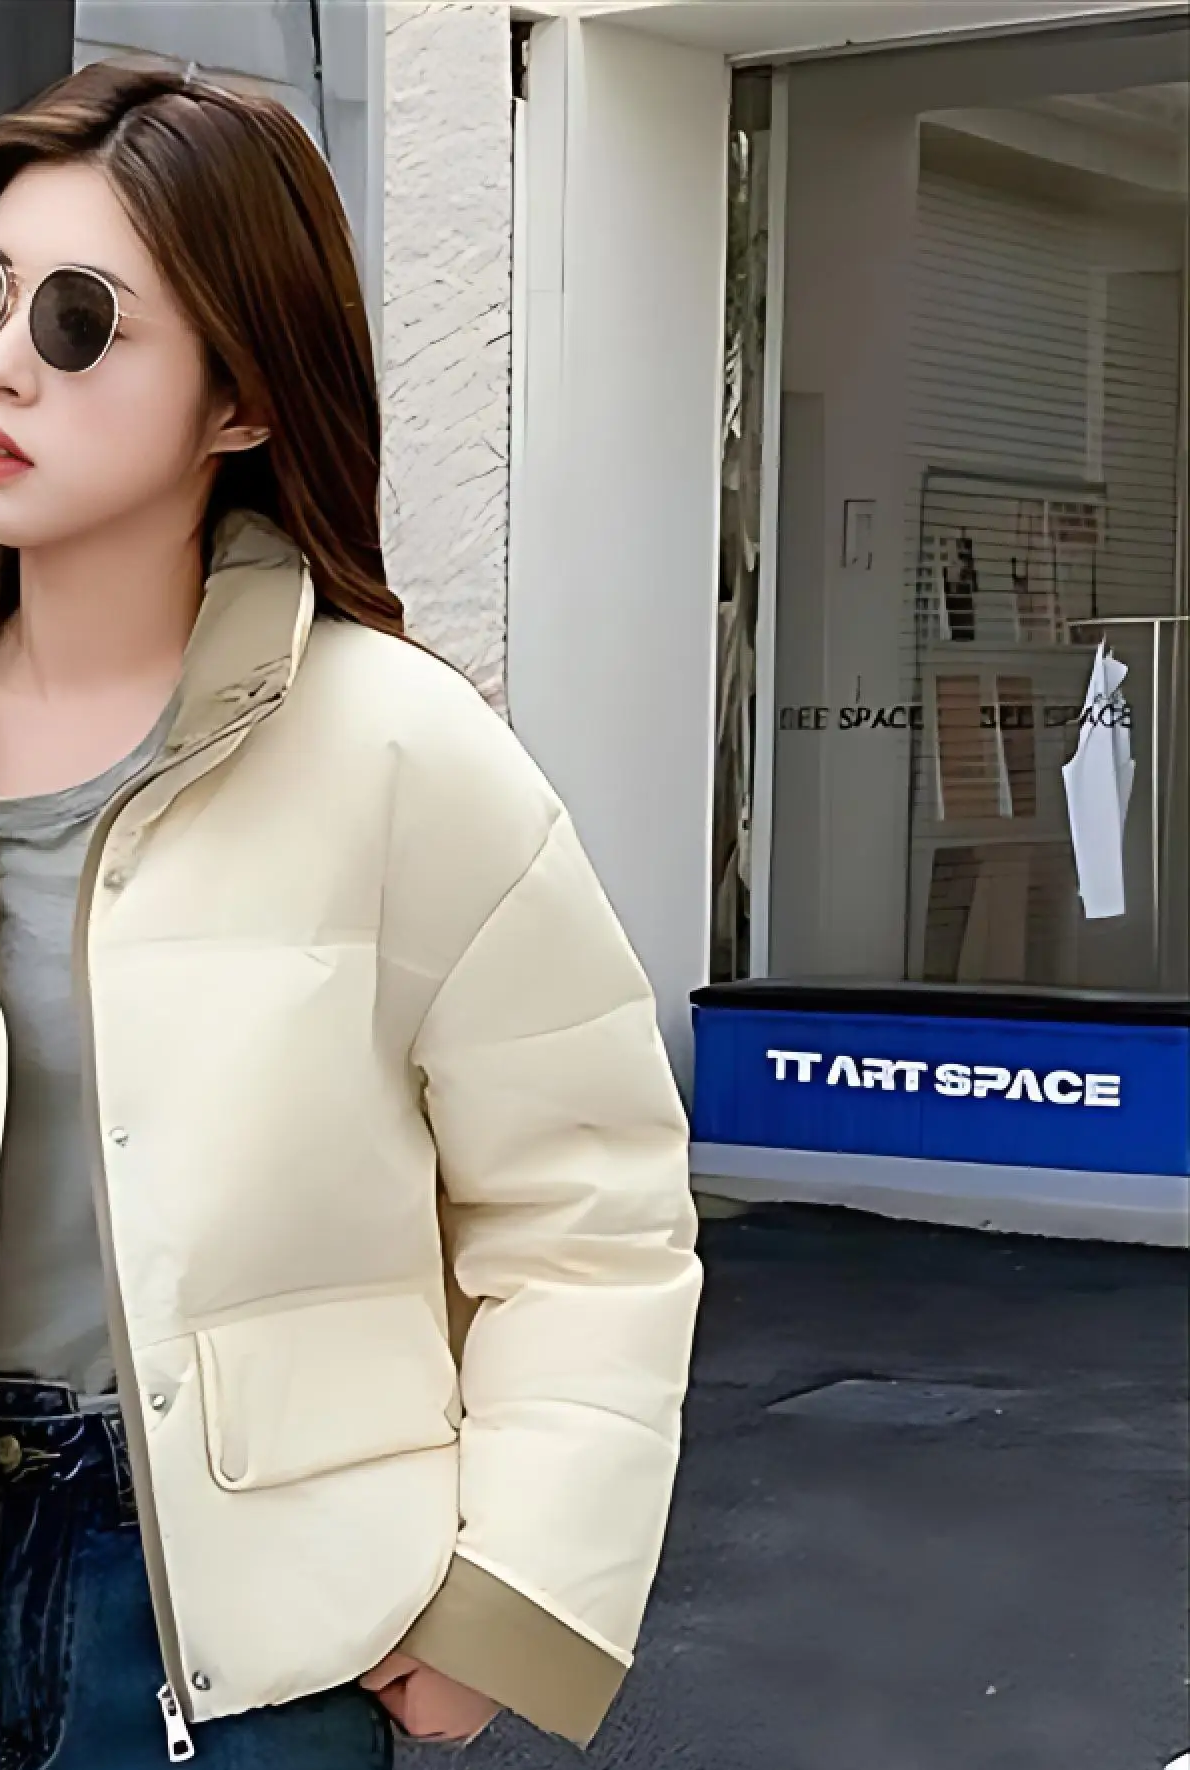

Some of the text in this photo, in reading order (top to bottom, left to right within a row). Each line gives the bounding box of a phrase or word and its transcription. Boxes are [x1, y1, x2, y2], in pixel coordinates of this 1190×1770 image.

[765, 1049, 1121, 1107] TT ART SPACE
